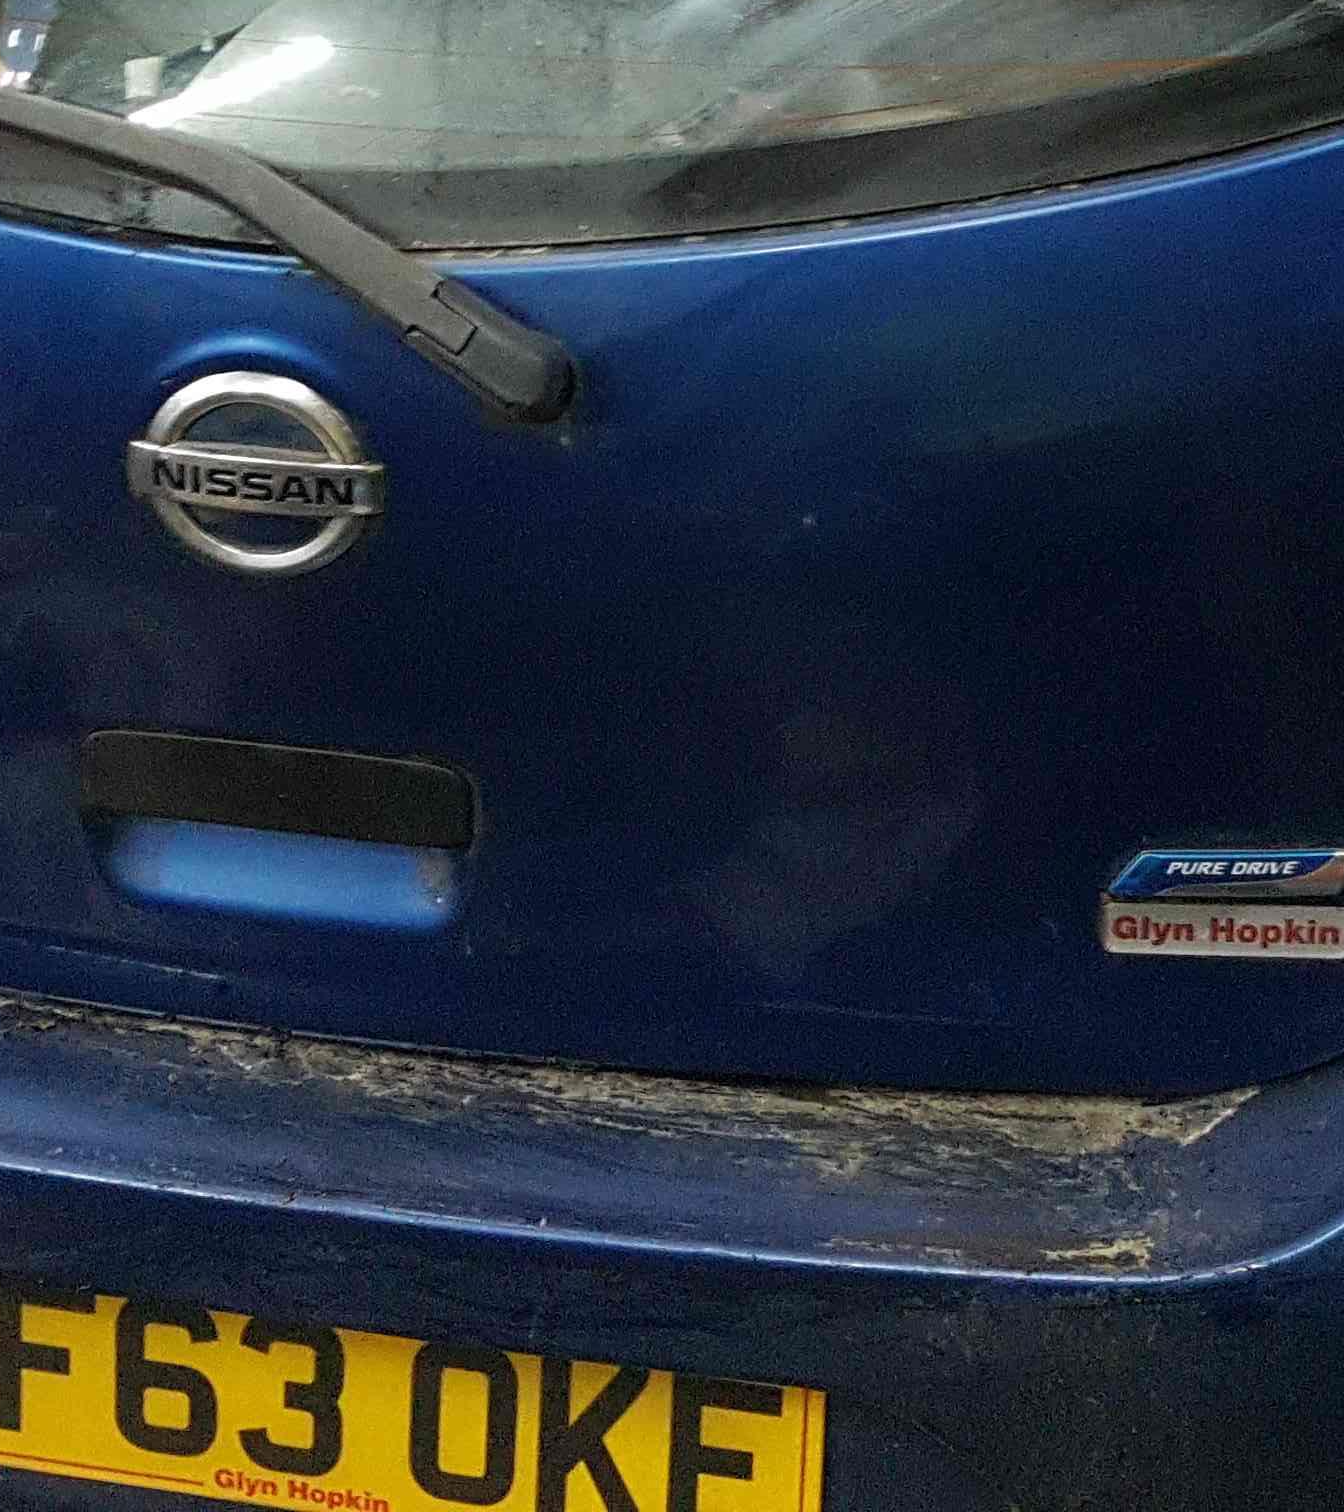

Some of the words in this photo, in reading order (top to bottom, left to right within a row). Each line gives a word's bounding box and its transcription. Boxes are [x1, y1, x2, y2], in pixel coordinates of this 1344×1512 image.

[152, 457, 354, 506] NISSAN
[1166, 861, 1228, 876] PURE
[1230, 860, 1300, 876] DRIVE
[1110, 914, 1195, 946] Glyn
[1209, 916, 1341, 948] Hopkin
[408, 1340, 784, 1512] OKF
[213, 1468, 279, 1497] Glyn
[287, 1479, 391, 1512] Hopkin
